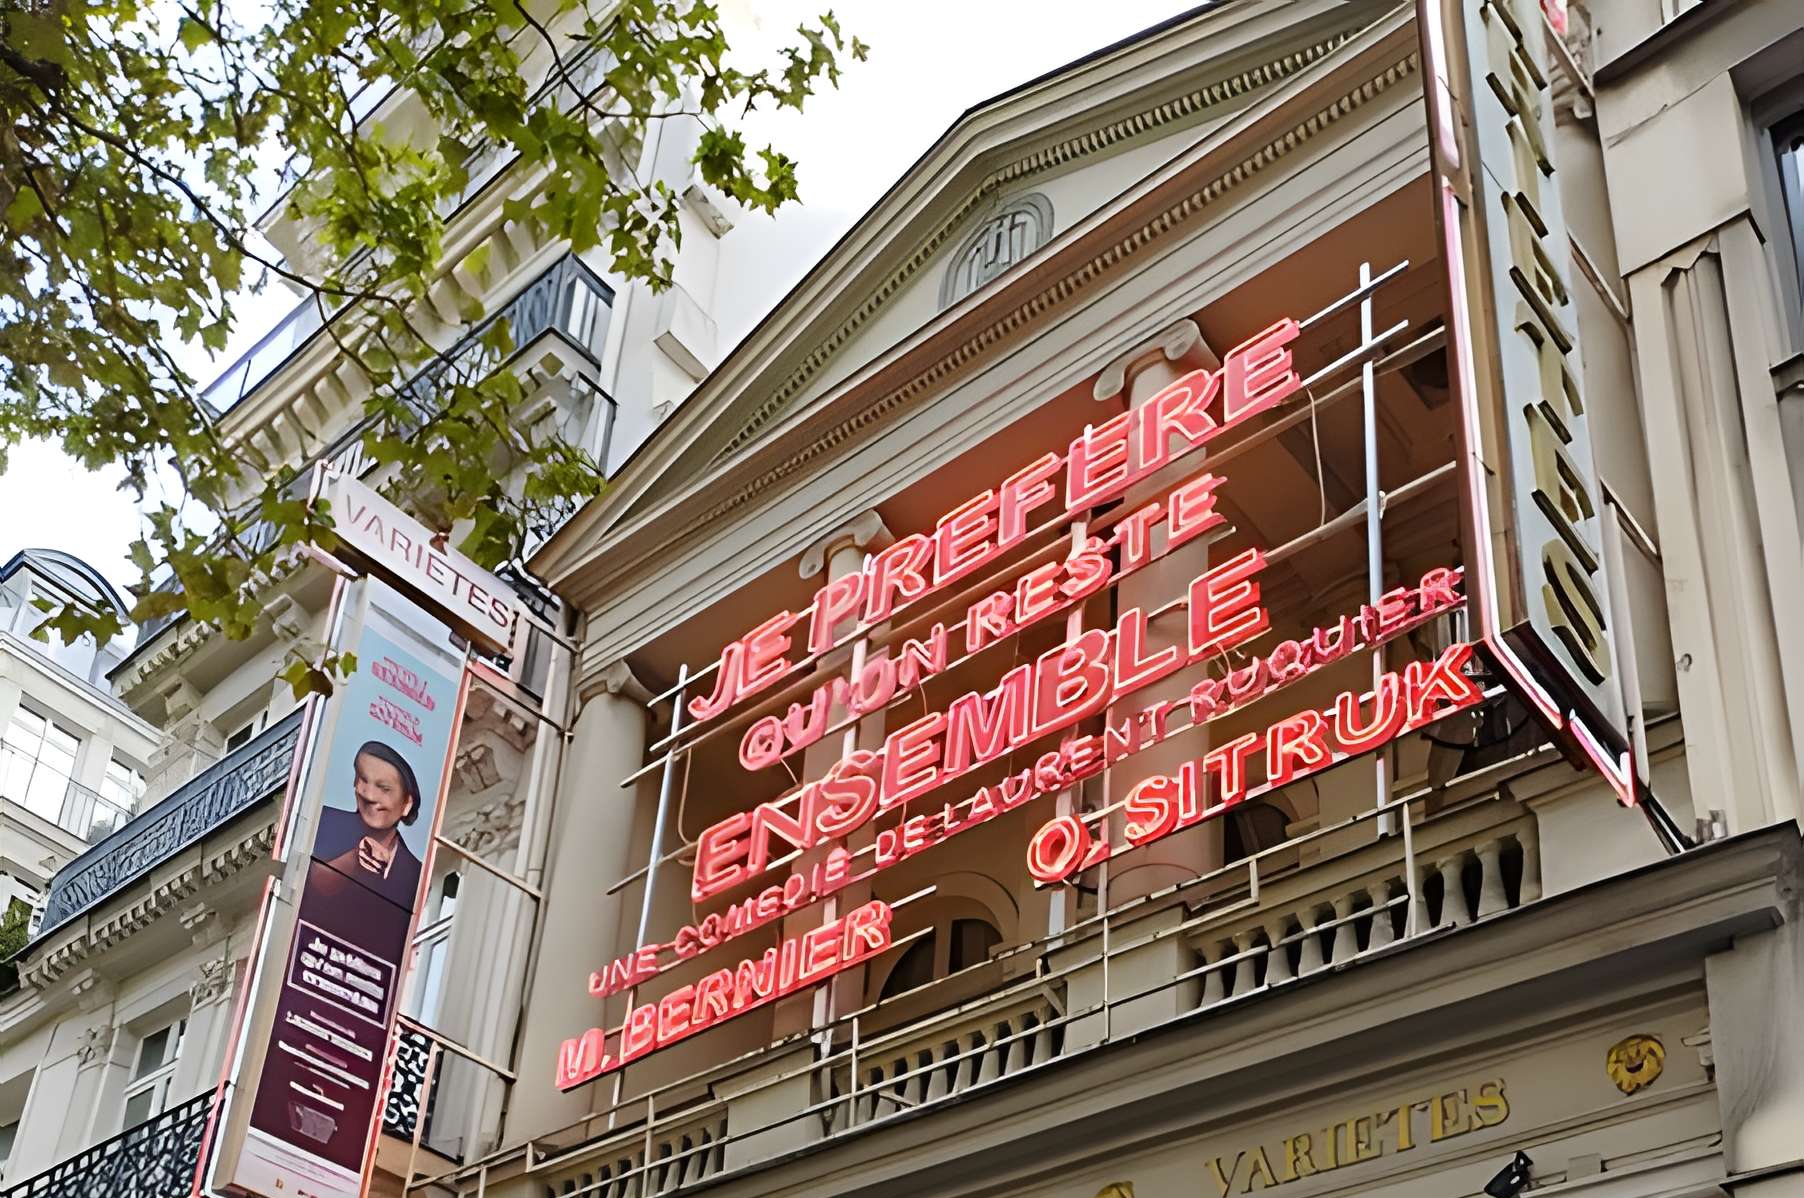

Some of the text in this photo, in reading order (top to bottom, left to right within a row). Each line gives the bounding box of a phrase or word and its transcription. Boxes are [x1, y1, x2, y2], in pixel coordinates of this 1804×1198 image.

[345, 493, 510, 629] VARIETES
[688, 317, 1302, 721] JE PREFERE
[966, 474, 1227, 654] RESTE
[691, 547, 1270, 903] ENSEMBLE
[1026, 643, 1484, 883] O. SITRUK
[588, 944, 660, 997] UNE
[674, 847, 851, 957] COMEDIE
[875, 814, 928, 867] DE
[943, 700, 1170, 829] LAURENT
[622, 899, 894, 1058] BERNIER
[1204, 1077, 1511, 1198] VARIETES
